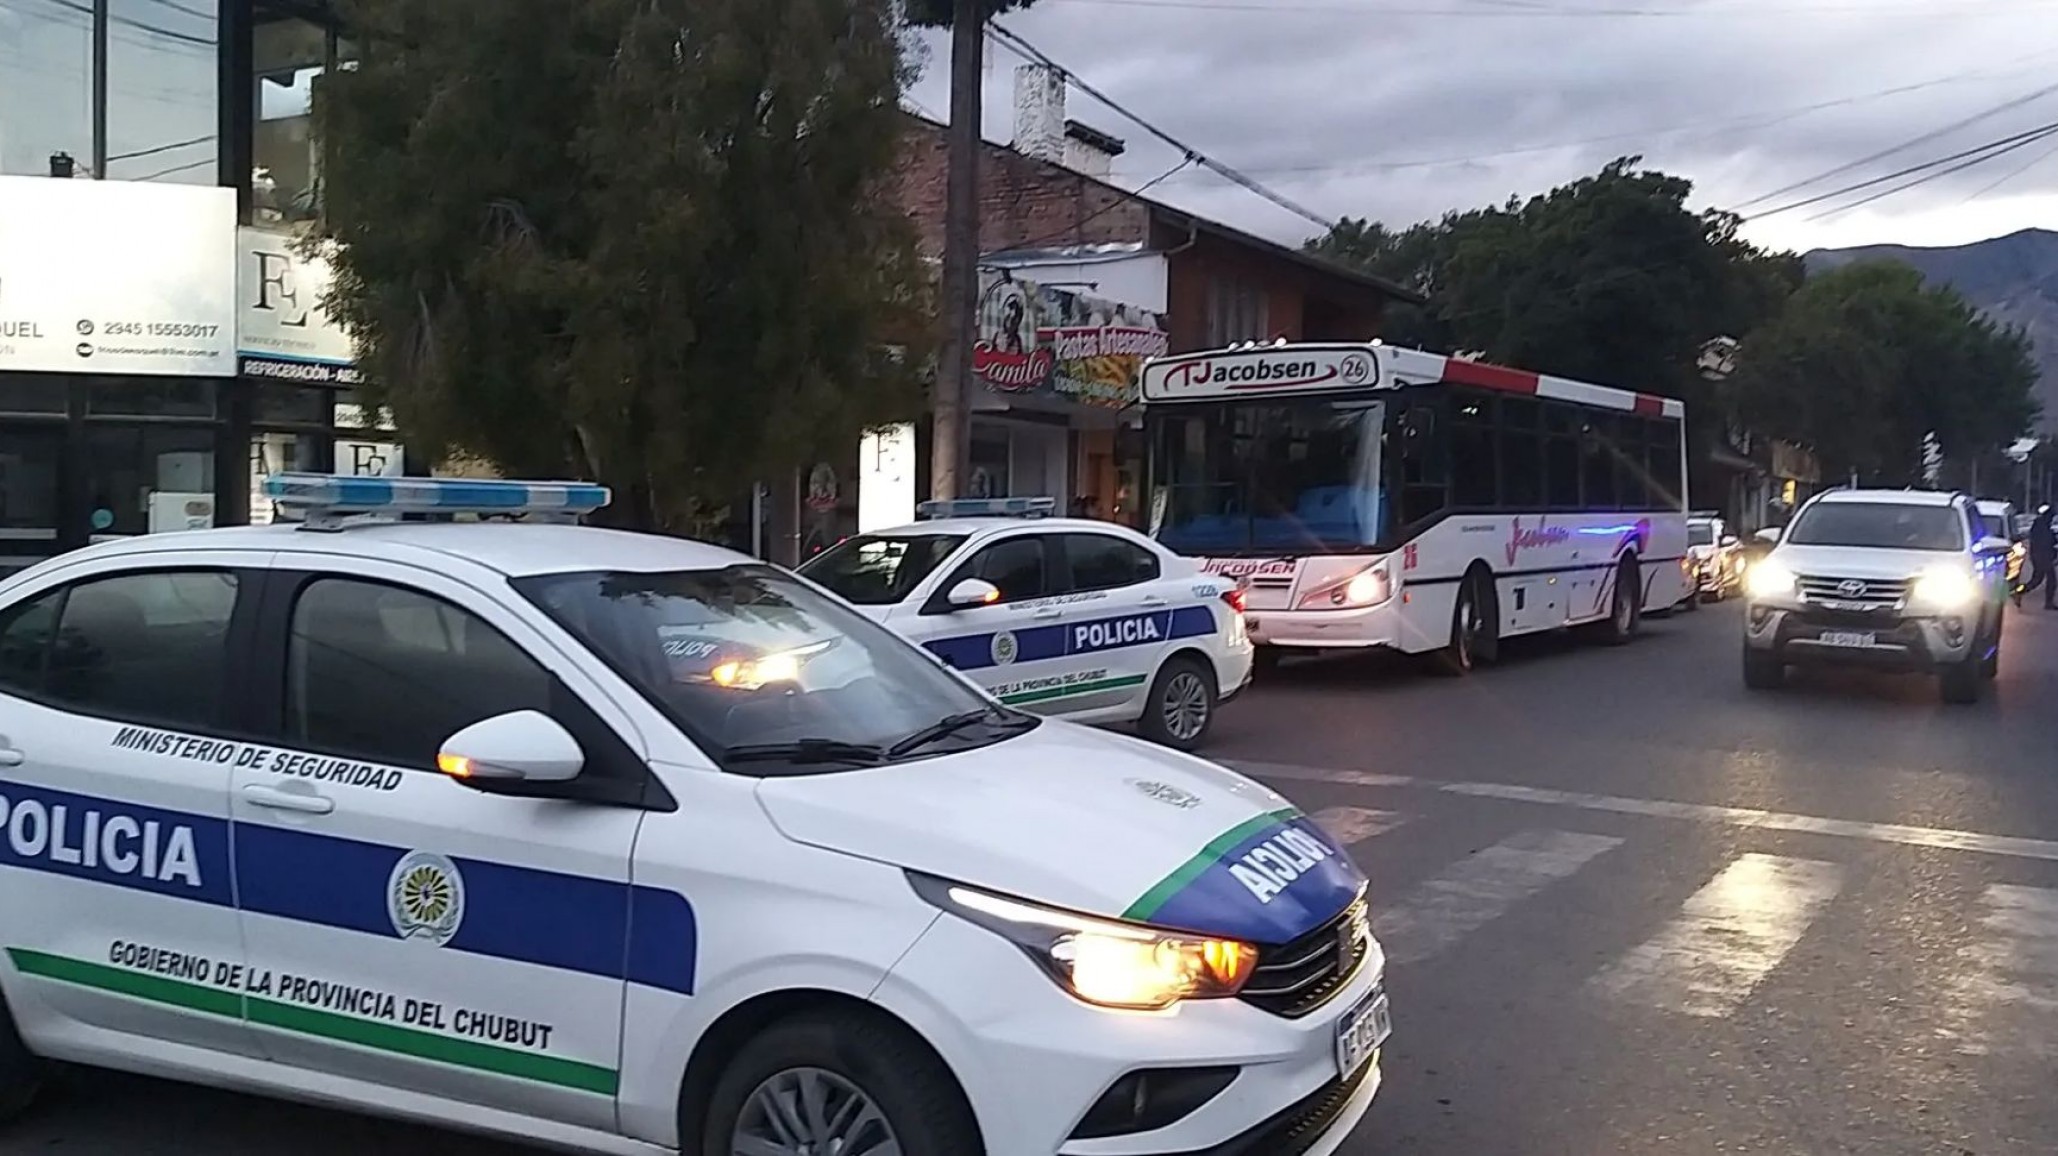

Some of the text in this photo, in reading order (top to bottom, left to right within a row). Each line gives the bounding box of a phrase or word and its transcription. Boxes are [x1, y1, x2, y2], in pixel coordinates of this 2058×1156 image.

[0, 321, 44, 338] UEL
[103, 321, 219, 338] 2945 15553017
[972, 338, 1049, 388] Camila
[1344, 360, 1364, 378] 26
[1075, 617, 1160, 649] POLICIA
[111, 727, 403, 791] MINISTERIO DE SEGURIDAD
[0, 795, 202, 887] OLICIA
[109, 940, 553, 1050] GOBIERNO DE LA PROVINCIA DEL CHUBUT
